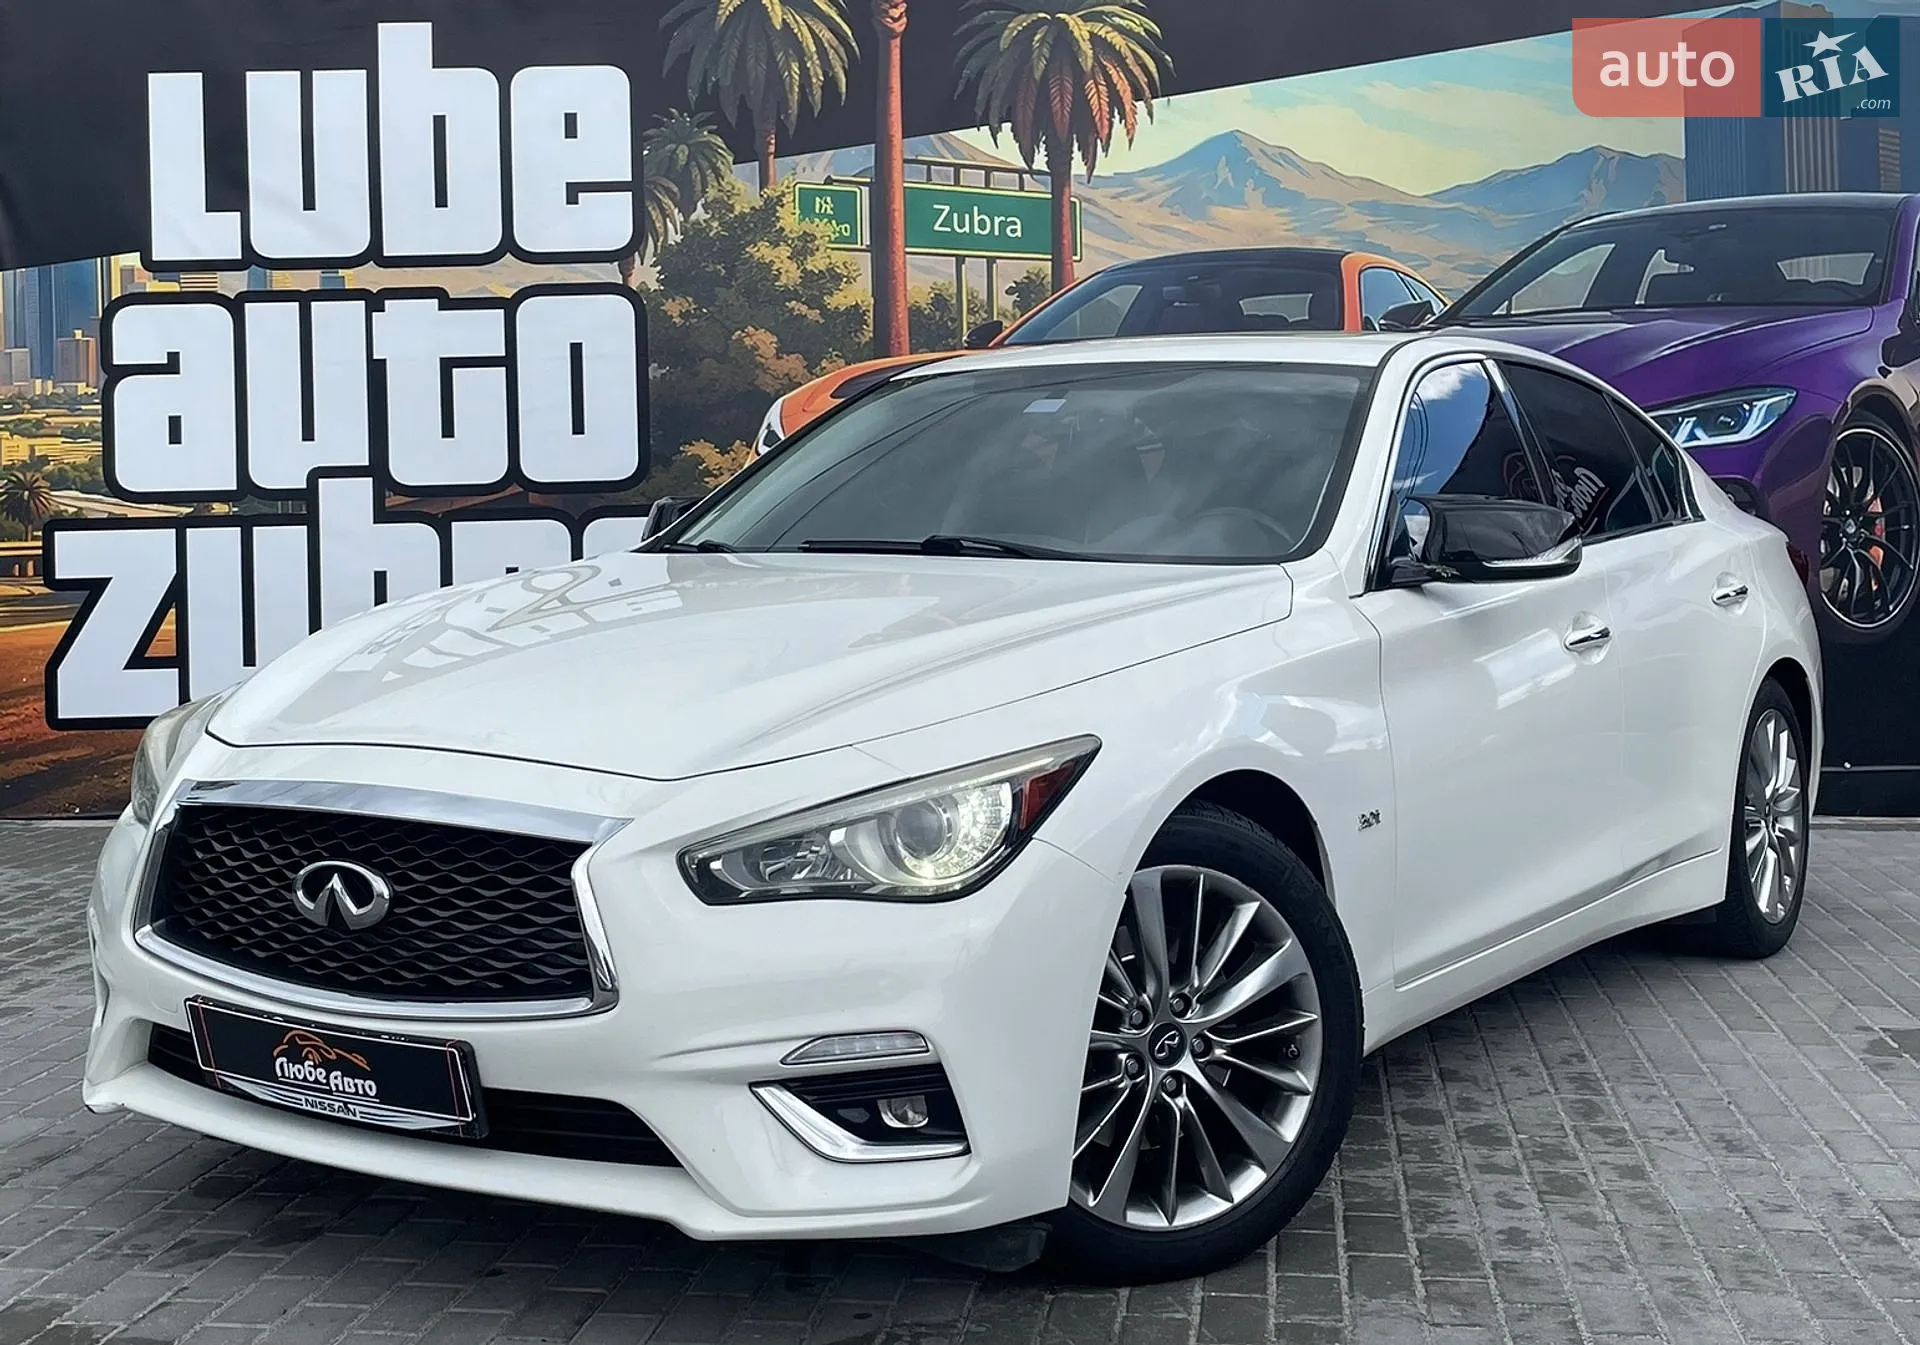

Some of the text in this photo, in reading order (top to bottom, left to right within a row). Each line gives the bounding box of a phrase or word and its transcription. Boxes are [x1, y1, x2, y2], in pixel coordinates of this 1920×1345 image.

[932, 203, 1023, 238] Zubra
[110, 294, 639, 492] auto
[329, 1070, 377, 1097] Авто
[303, 1098, 358, 1118] NISSAN
